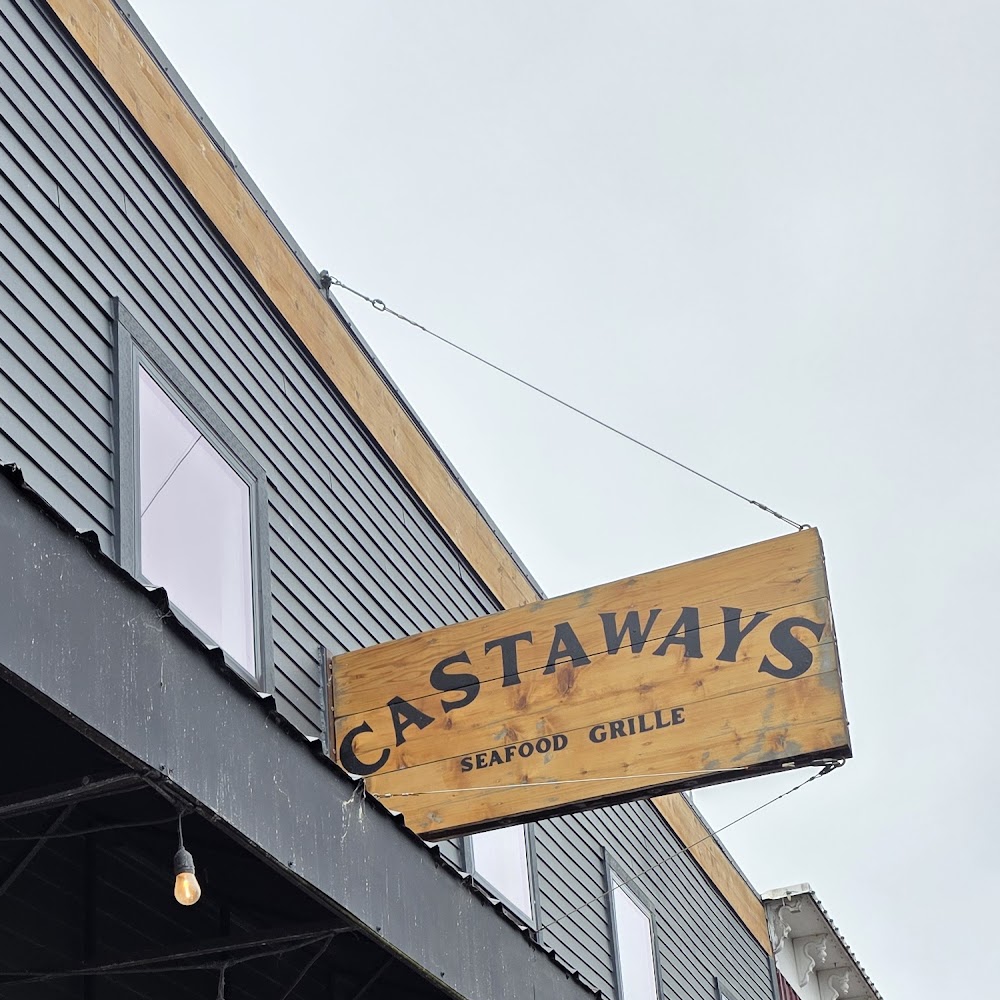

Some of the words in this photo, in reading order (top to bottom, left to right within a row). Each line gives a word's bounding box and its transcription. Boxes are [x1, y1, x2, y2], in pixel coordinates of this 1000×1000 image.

[339, 606, 826, 776] CASTAWAYS
[460, 733, 569, 773] SEAFOOD
[588, 707, 686, 744] GRILLE
